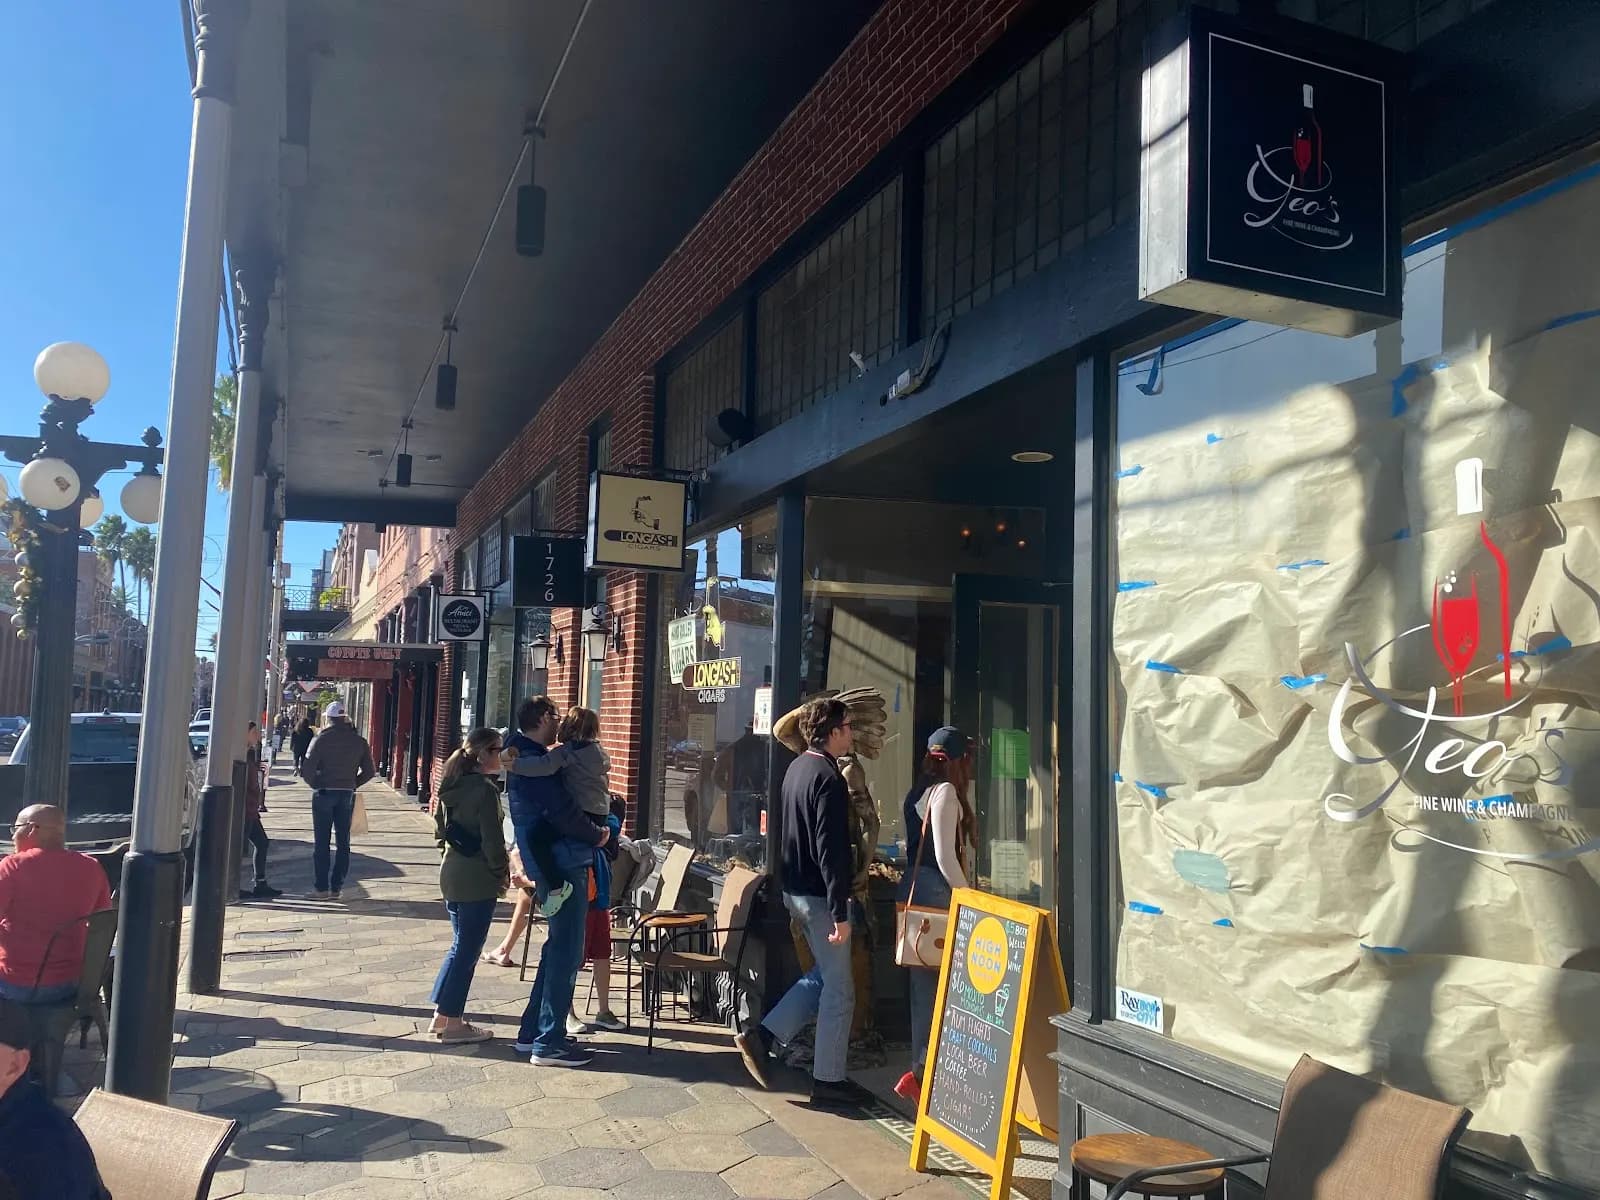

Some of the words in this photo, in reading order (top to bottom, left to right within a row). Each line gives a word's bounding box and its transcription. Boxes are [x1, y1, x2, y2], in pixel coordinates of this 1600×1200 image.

[627, 544, 661, 552] CIGARS
[543, 543, 555, 602] 1726
[698, 689, 726, 703] CIGARS
[1414, 795, 1439, 811] FINE
[1440, 797, 1474, 814] WINE
[1476, 800, 1486, 815] &
[960, 907, 977, 925] HAPPY
[975, 937, 1002, 956] HIGH
[971, 952, 1001, 974] NOON
[952, 971, 965, 993] $6
[964, 985, 985, 1005] MOJITO
[951, 1009, 966, 1031] RUM
[968, 1017, 992, 1041] FLIGHTS
[948, 1028, 967, 1047] CRAFT
[967, 1036, 998, 1064] COCKTAILS
[944, 1056, 968, 1082] COFFEE
[946, 1042, 965, 1064] LOCAL
[968, 1053, 988, 1078] BEER
[943, 1093, 972, 1121] CIGARS
